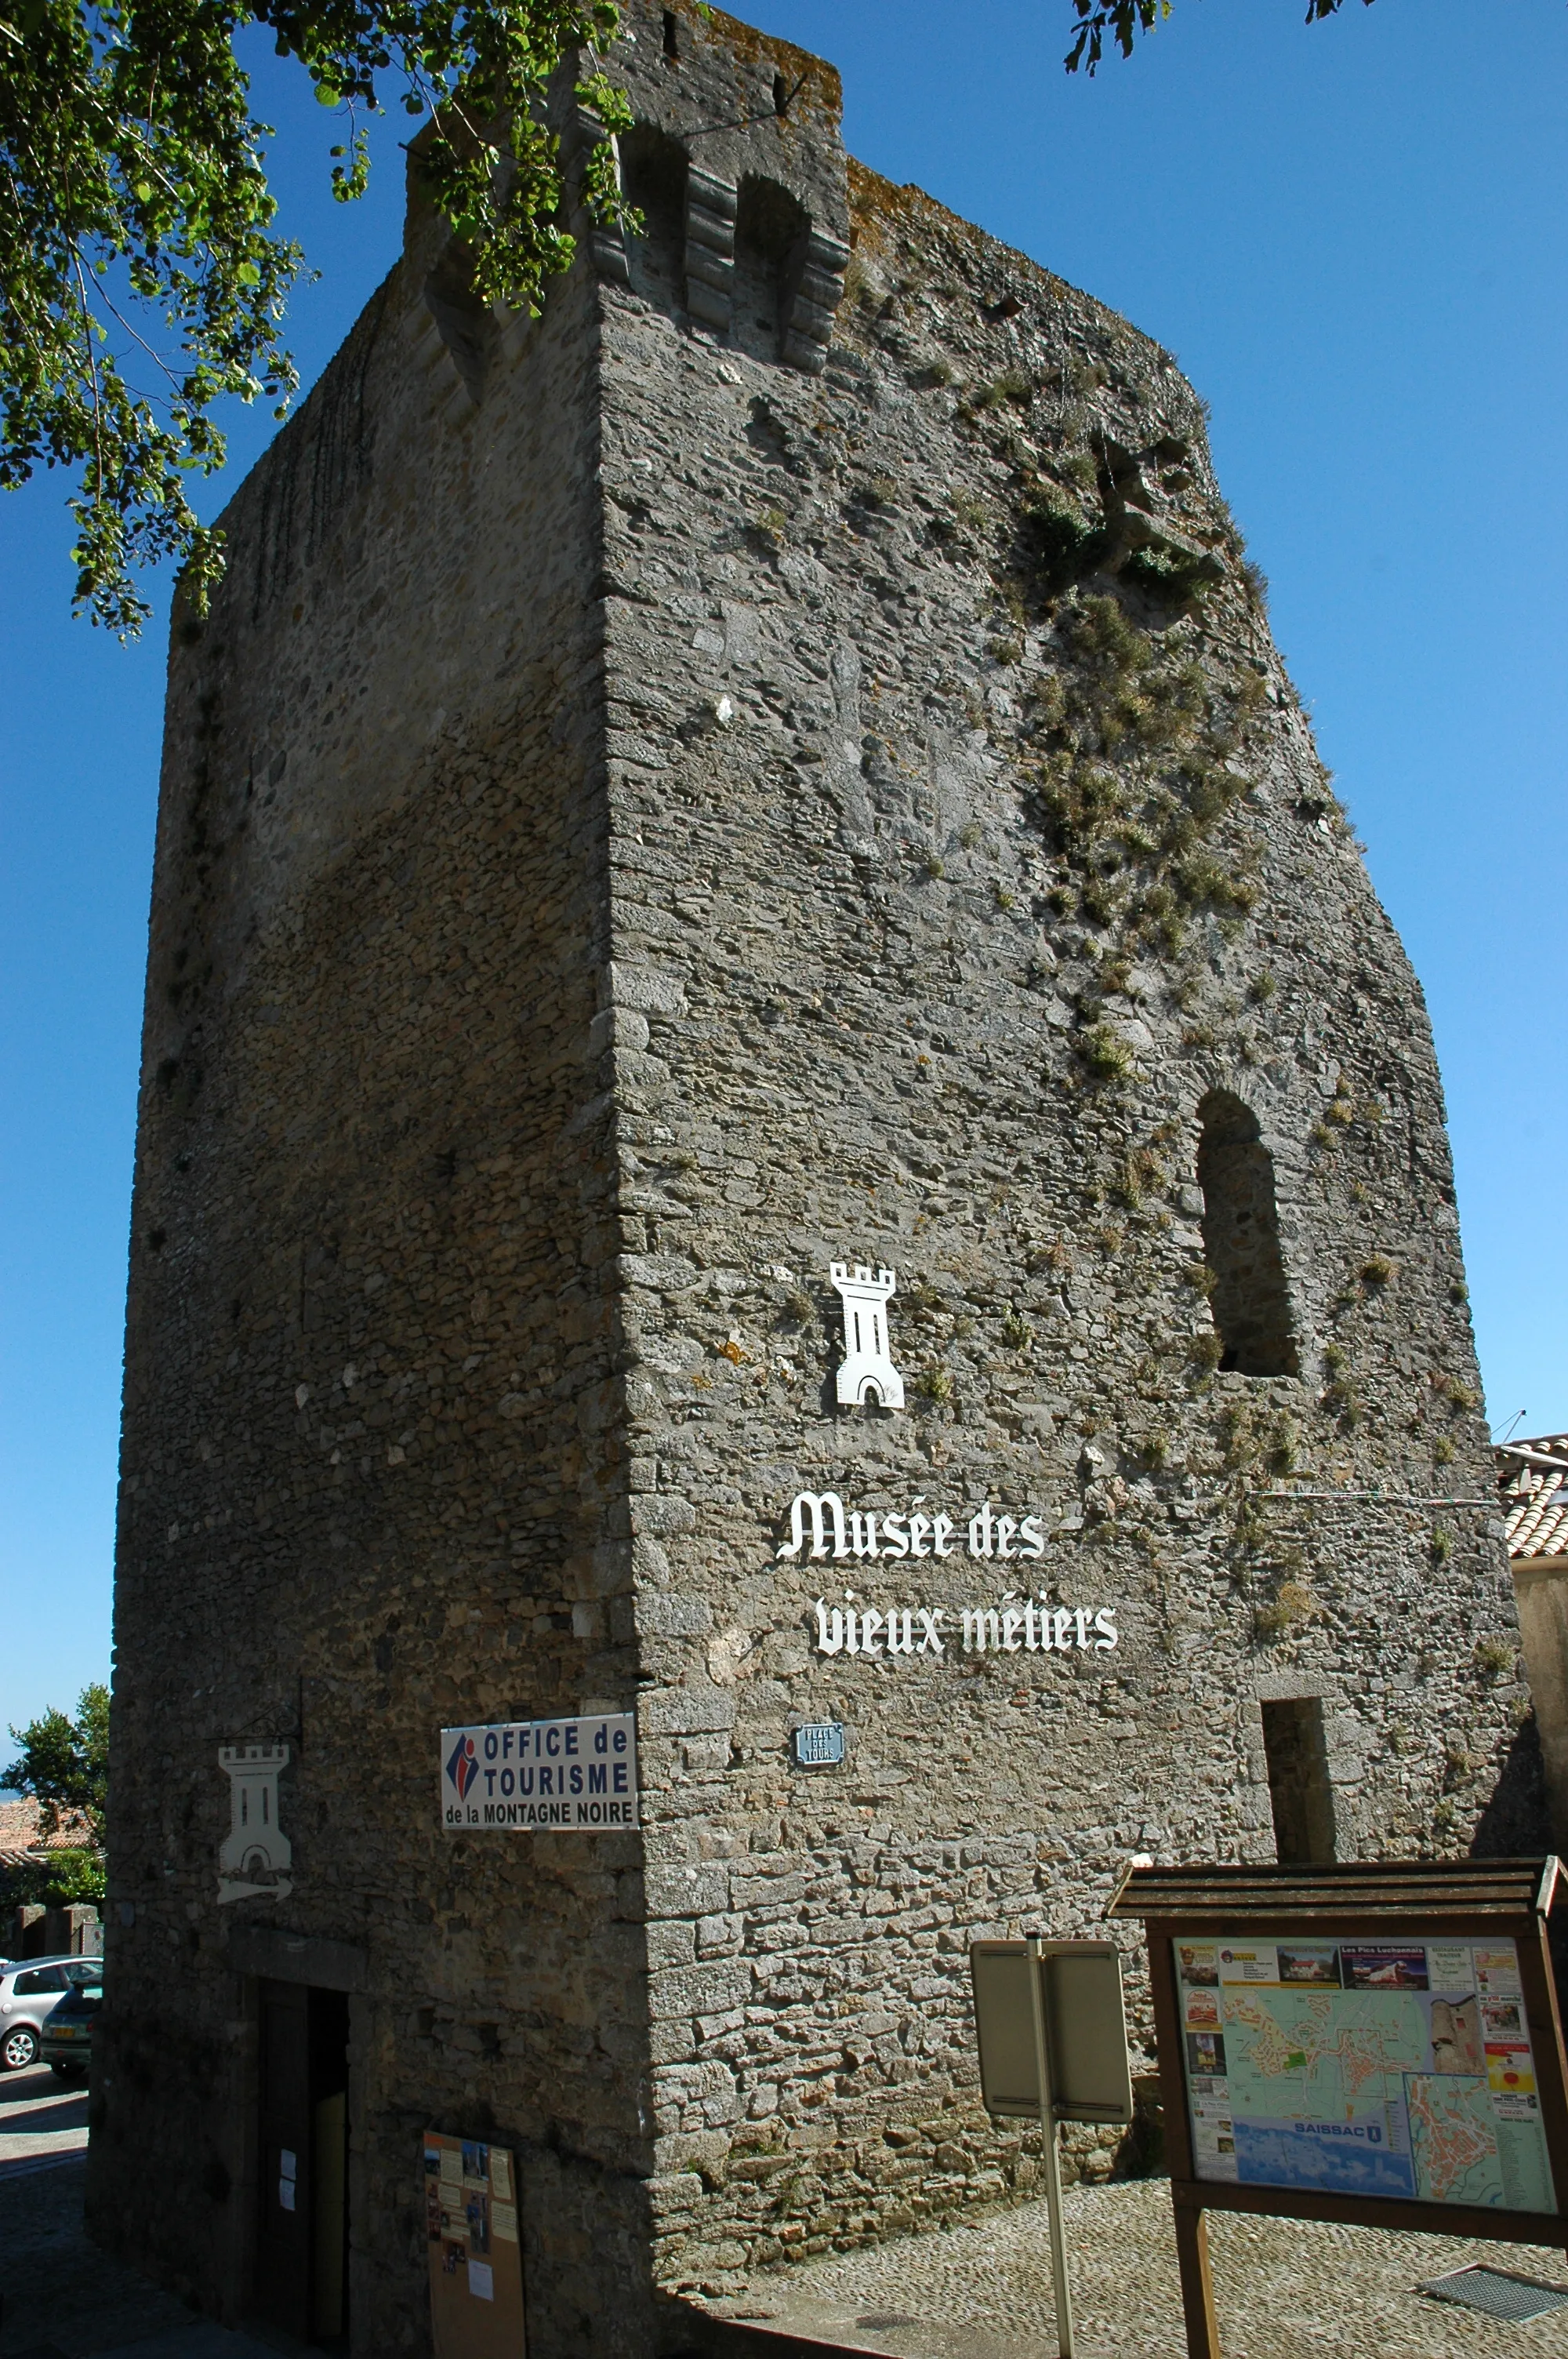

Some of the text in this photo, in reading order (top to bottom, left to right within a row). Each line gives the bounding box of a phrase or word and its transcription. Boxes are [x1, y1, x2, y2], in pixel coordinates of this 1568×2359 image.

[776, 1492, 1045, 1559] Musée des
[816, 1589, 1118, 1655] vieux métiers
[484, 1723, 627, 1760] OFFICE de
[806, 1728, 833, 1739] PLACE
[812, 1739, 827, 1748] DES
[806, 1748, 833, 1760] TOURS
[484, 1761, 628, 1797] TOURISME
[446, 1802, 633, 1824] de la MONTAGNE NOIRE
[1294, 2122, 1365, 2137] SAISSAC
